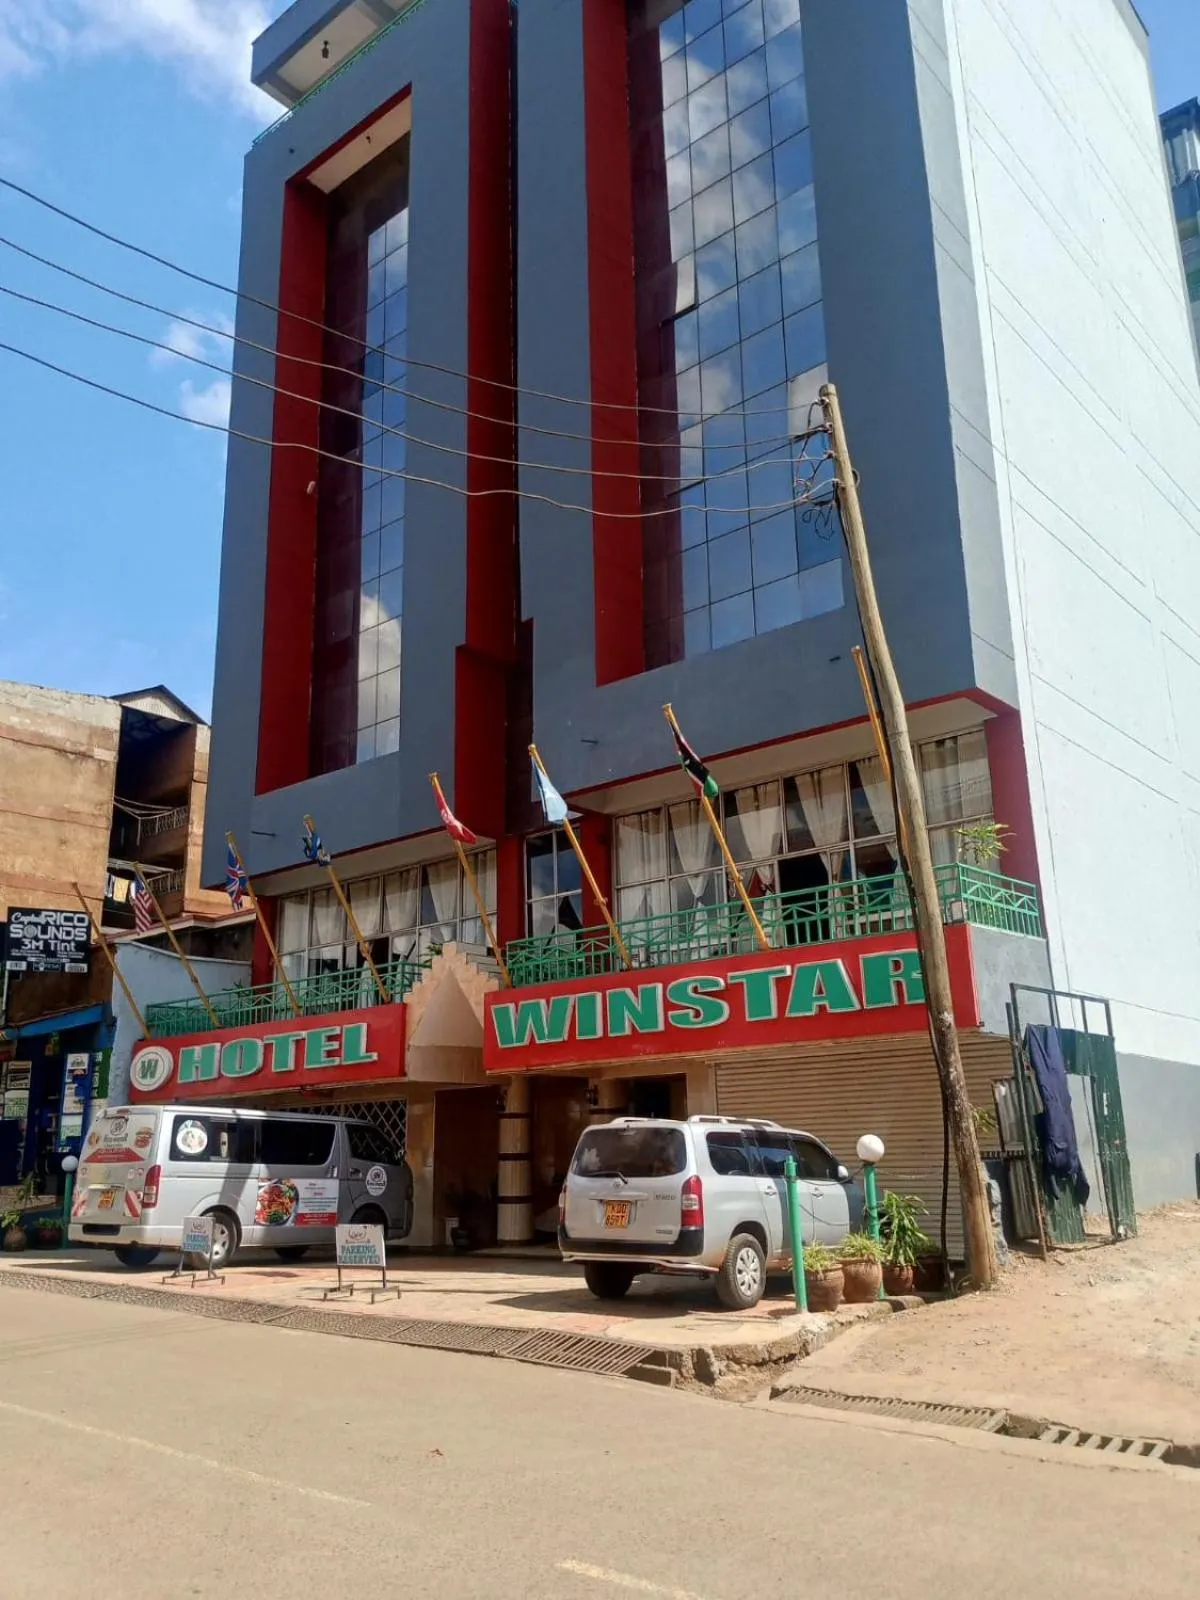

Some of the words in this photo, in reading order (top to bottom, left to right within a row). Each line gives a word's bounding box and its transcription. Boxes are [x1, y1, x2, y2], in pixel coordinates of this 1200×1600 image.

[41, 911, 89, 926] RICO
[9, 924, 87, 940] SOUNDS
[21, 939, 44, 950] 3M
[48, 939, 76, 952] Tint
[492, 948, 926, 1048] WINSTAR
[177, 1022, 378, 1084] HOTEL
[341, 1244, 376, 1254] PARKING
[338, 1254, 381, 1264] RESERVED
